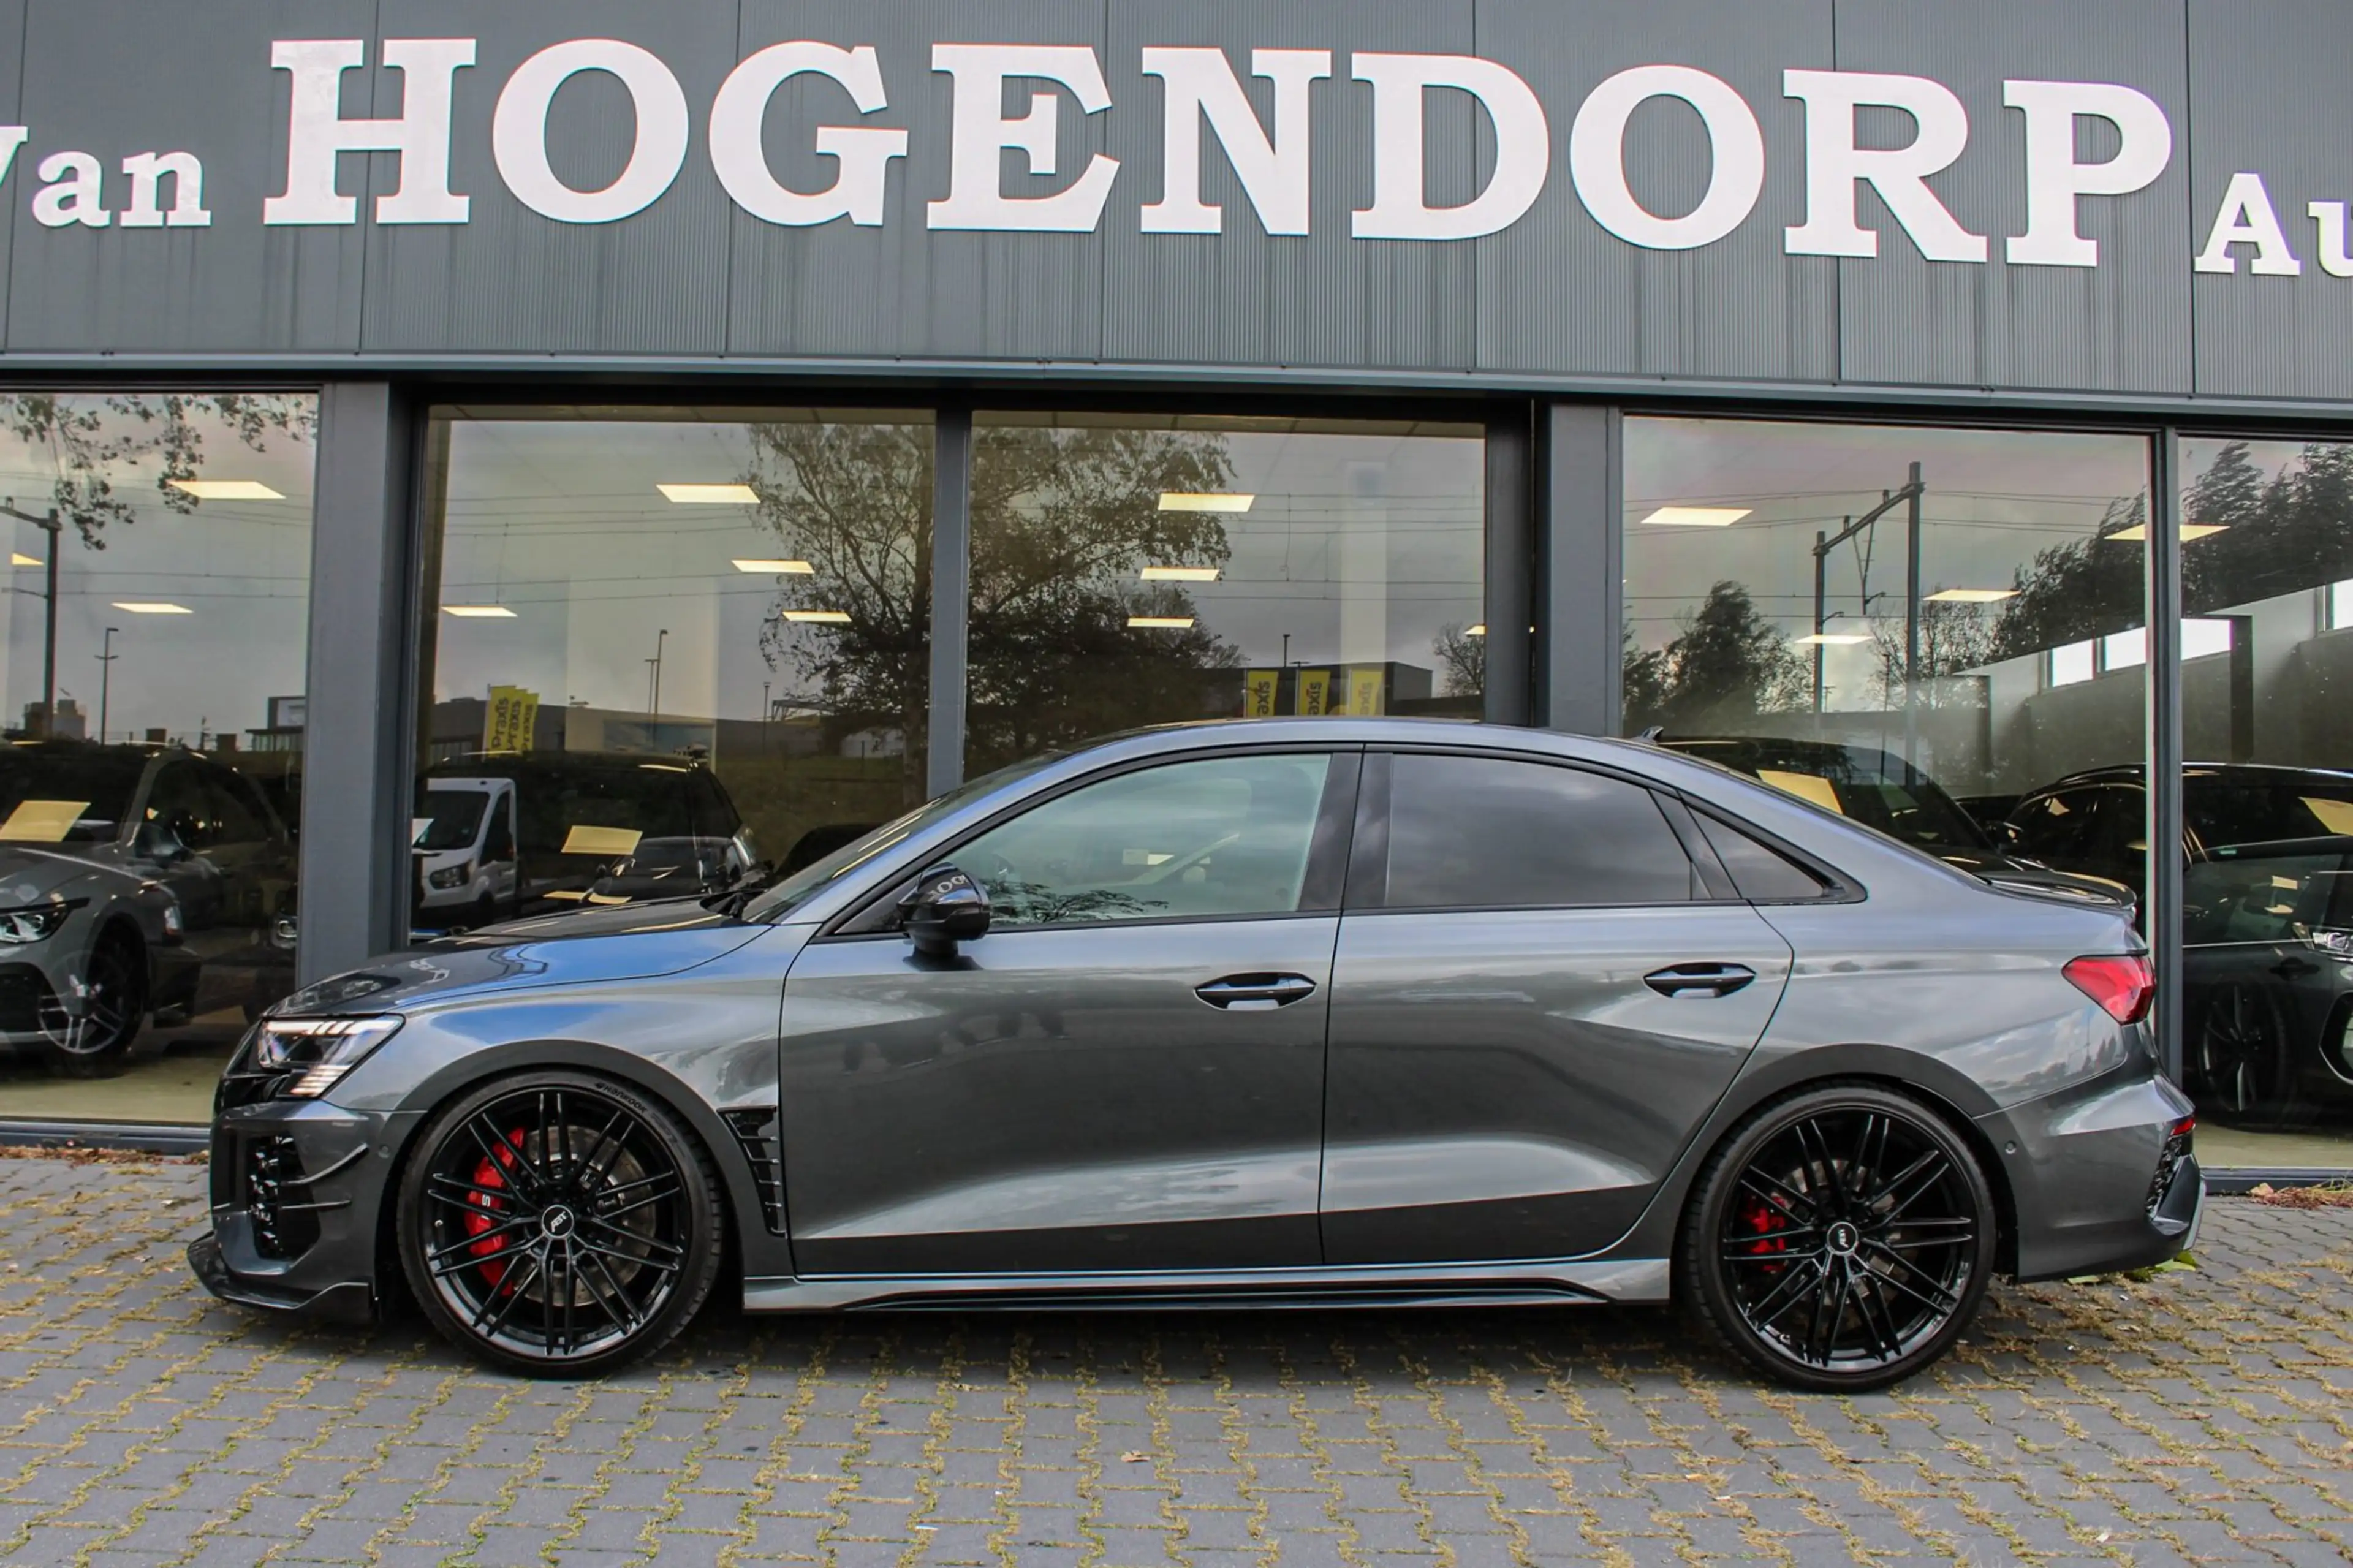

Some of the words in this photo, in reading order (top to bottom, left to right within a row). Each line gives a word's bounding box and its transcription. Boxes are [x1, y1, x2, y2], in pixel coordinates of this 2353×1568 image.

[0, 126, 211, 227] an
[263, 38, 2172, 267] HOGENDORP
[550, 1210, 567, 1233] ABT
